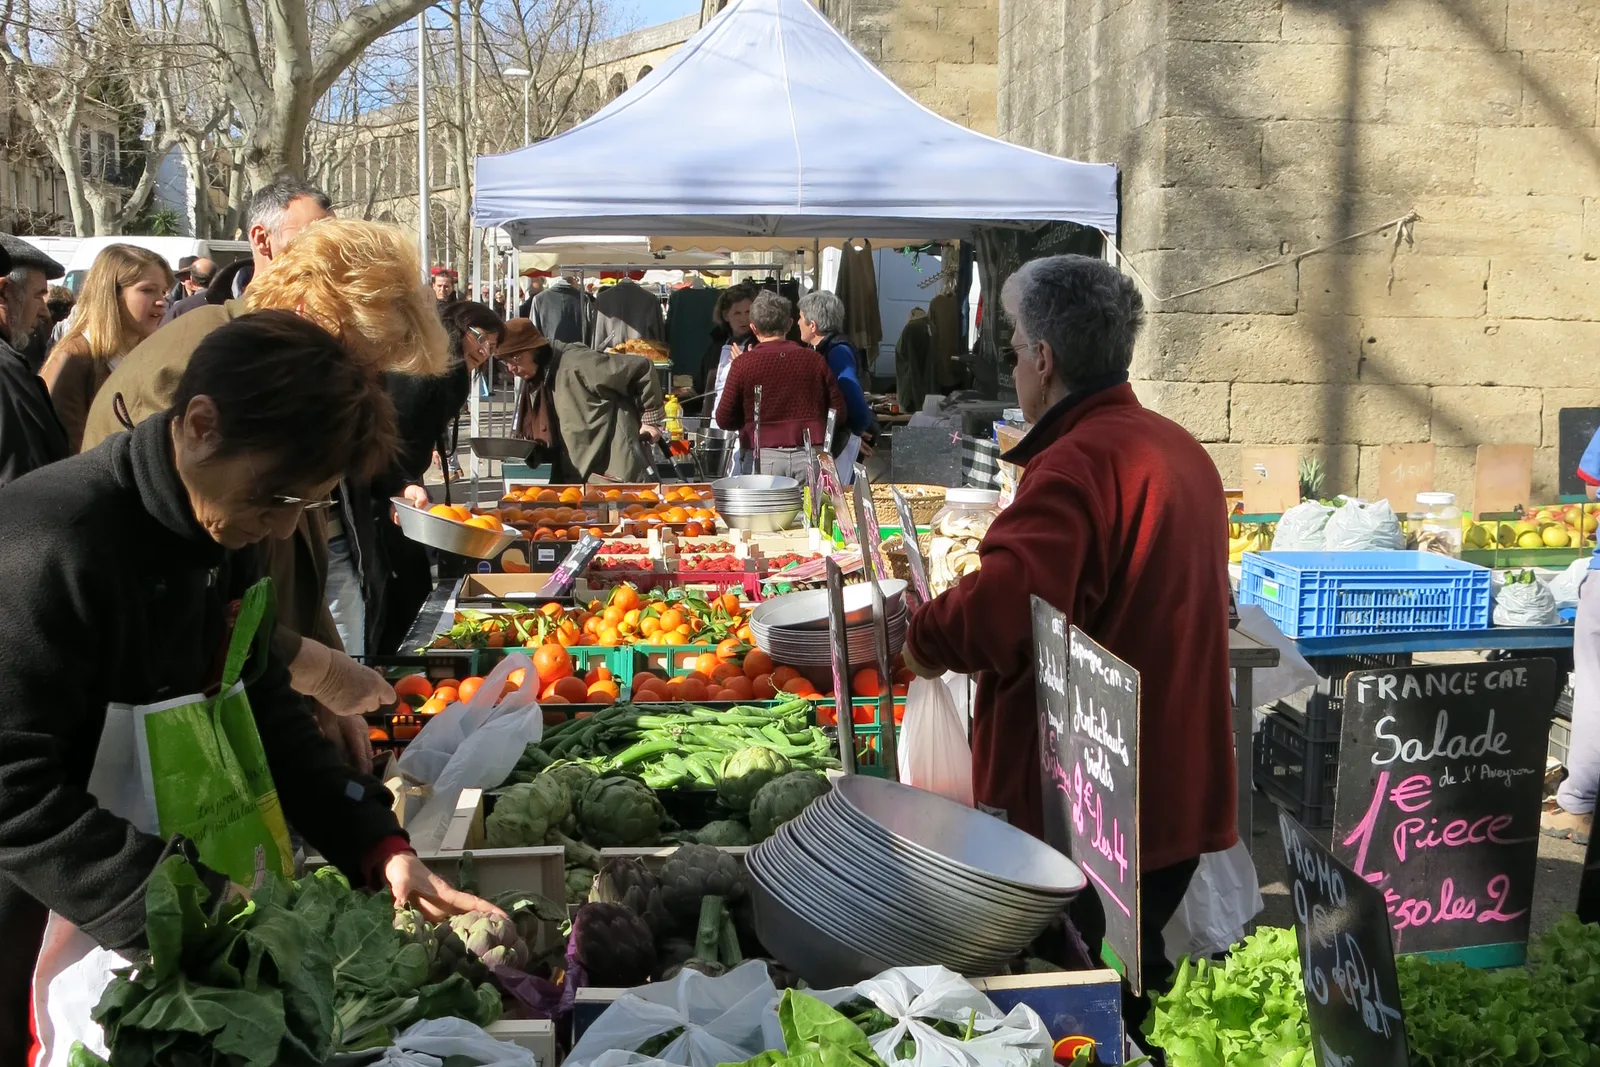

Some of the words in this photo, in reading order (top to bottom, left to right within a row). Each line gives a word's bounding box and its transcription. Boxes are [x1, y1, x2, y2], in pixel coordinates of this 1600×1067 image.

[1357, 671, 1478, 703] FRANCE
[1073, 684, 1129, 767] Artichauts
[1371, 709, 1511, 765] Salade
[1438, 766, 1457, 787] de
[1114, 817, 1128, 884] 4
[1432, 877, 1476, 923] les
[1477, 874, 1528, 923] 2
